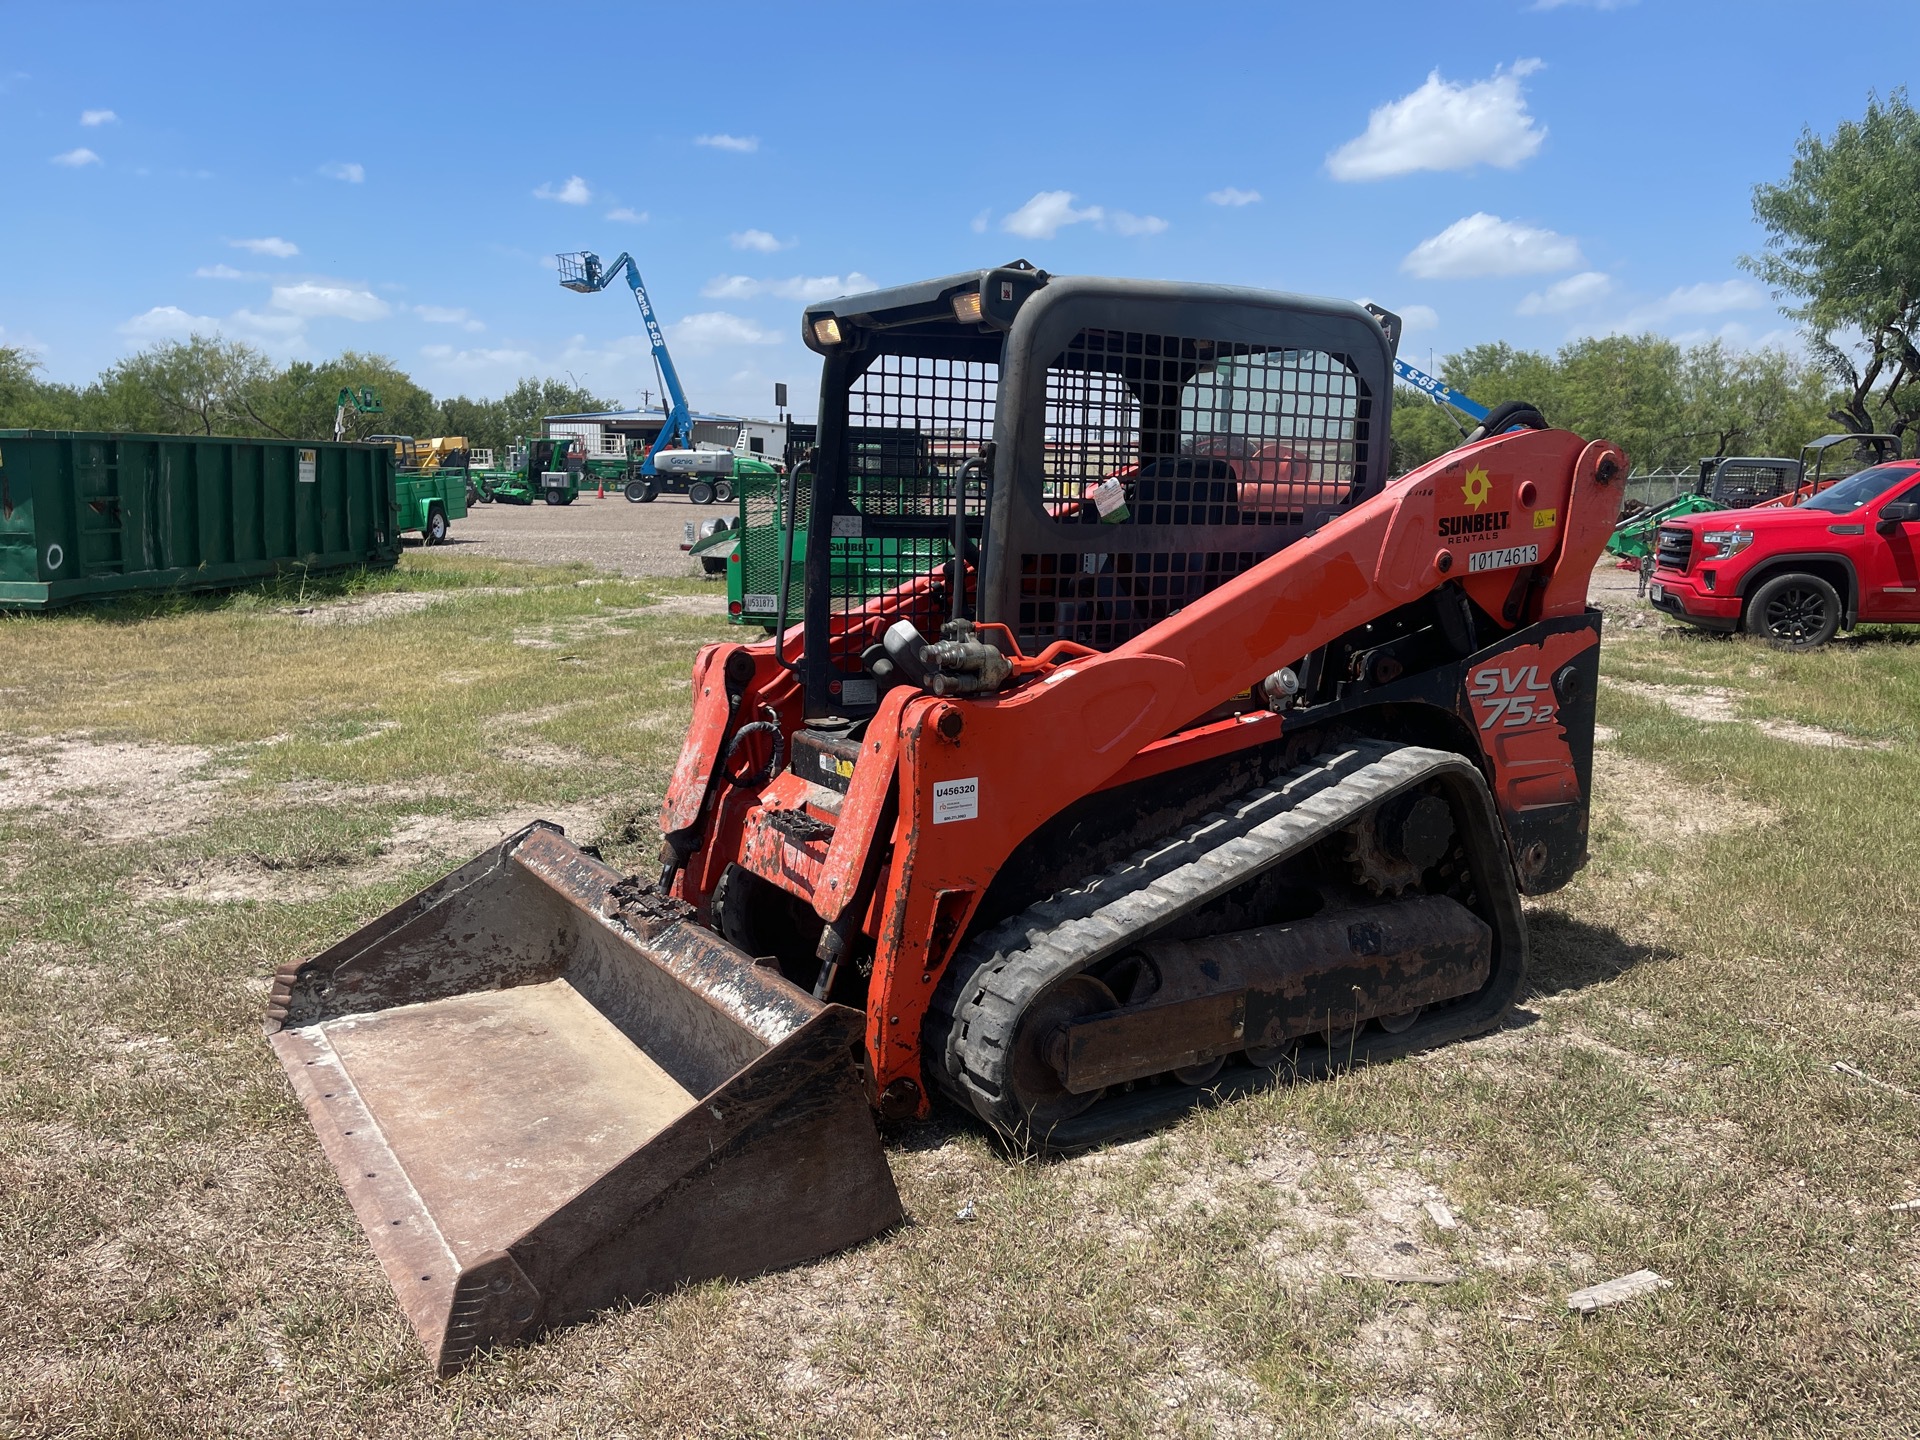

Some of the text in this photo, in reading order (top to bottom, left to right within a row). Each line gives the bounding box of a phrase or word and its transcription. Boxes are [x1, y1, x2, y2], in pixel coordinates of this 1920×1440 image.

[635, 286, 664, 347] Genie S-65
[1406, 369, 1438, 390] S-65
[670, 457, 693, 465] Genie
[1438, 511, 1509, 537] SUNBELT
[1448, 532, 1499, 545] RENTALS
[1470, 545, 1537, 572] 10174613
[747, 598, 775, 608] U531873
[1469, 665, 1550, 697] SVL
[1480, 695, 1554, 730] 75-2
[936, 784, 976, 798] U456320
